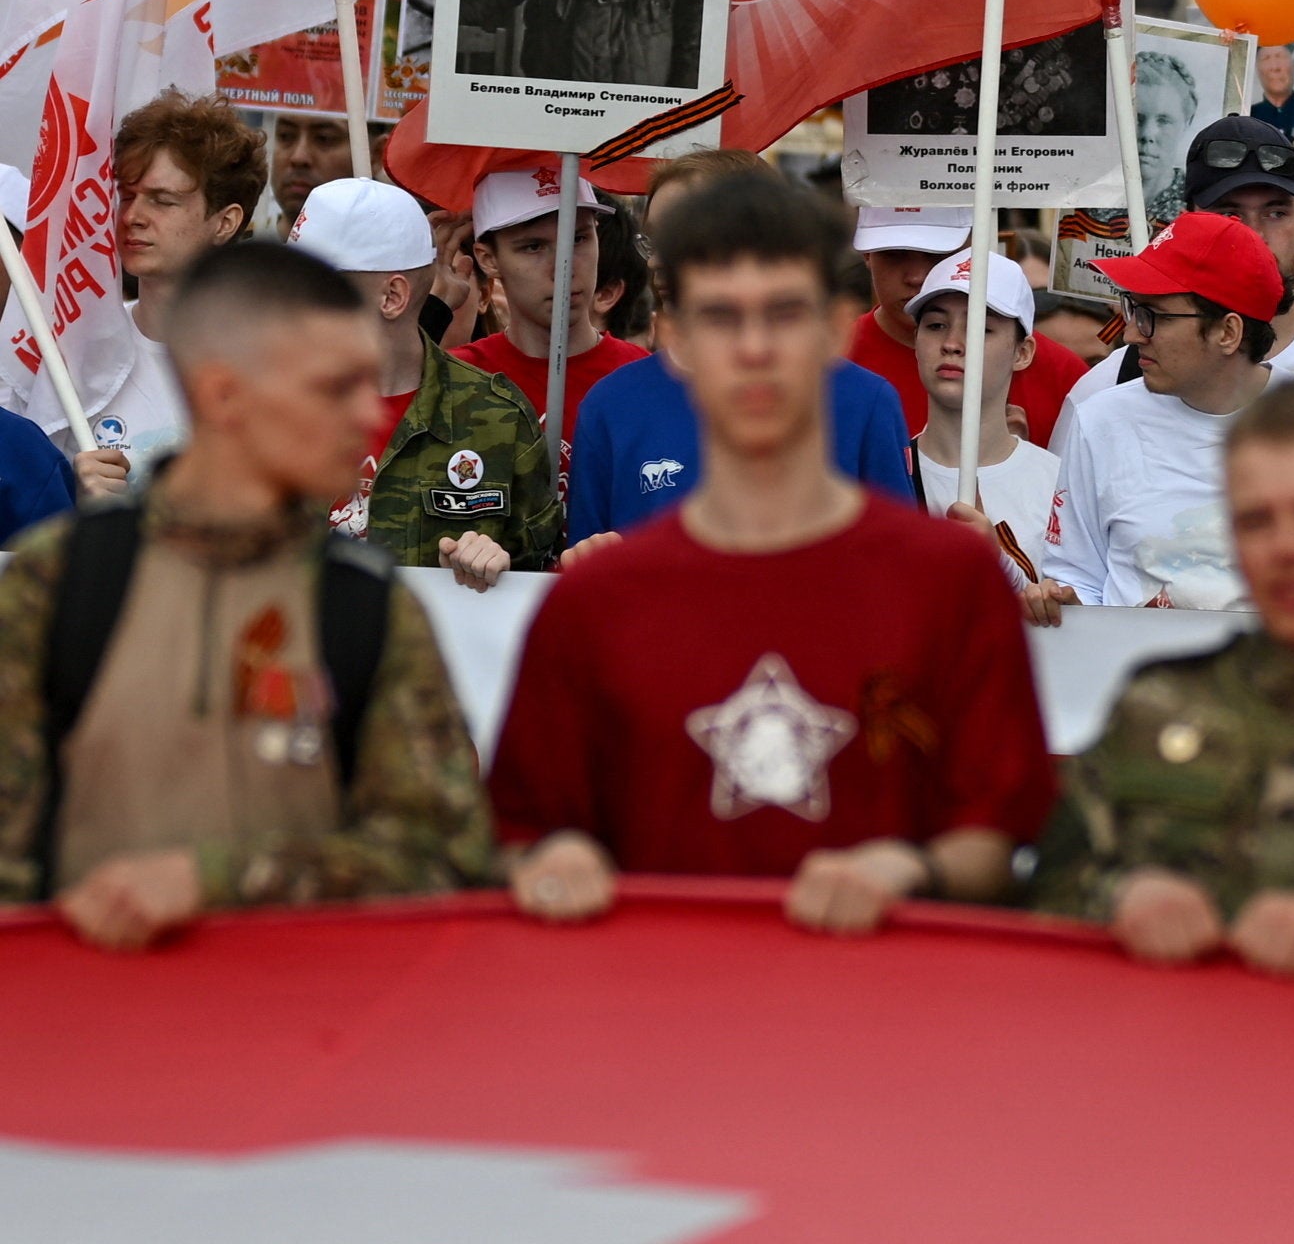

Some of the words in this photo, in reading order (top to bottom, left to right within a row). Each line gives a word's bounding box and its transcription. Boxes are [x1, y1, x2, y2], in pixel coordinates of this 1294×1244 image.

[283, 92, 315, 106] ПОЛК
[470, 82, 521, 95] Беляев
[524, 85, 596, 101] Владимир
[600, 90, 682, 106] Степанович
[544, 103, 606, 118] Сержант
[900, 145, 968, 158] Журавлёв
[1011, 146, 1075, 159] Егорович
[1006, 180, 1051, 193] фронт
